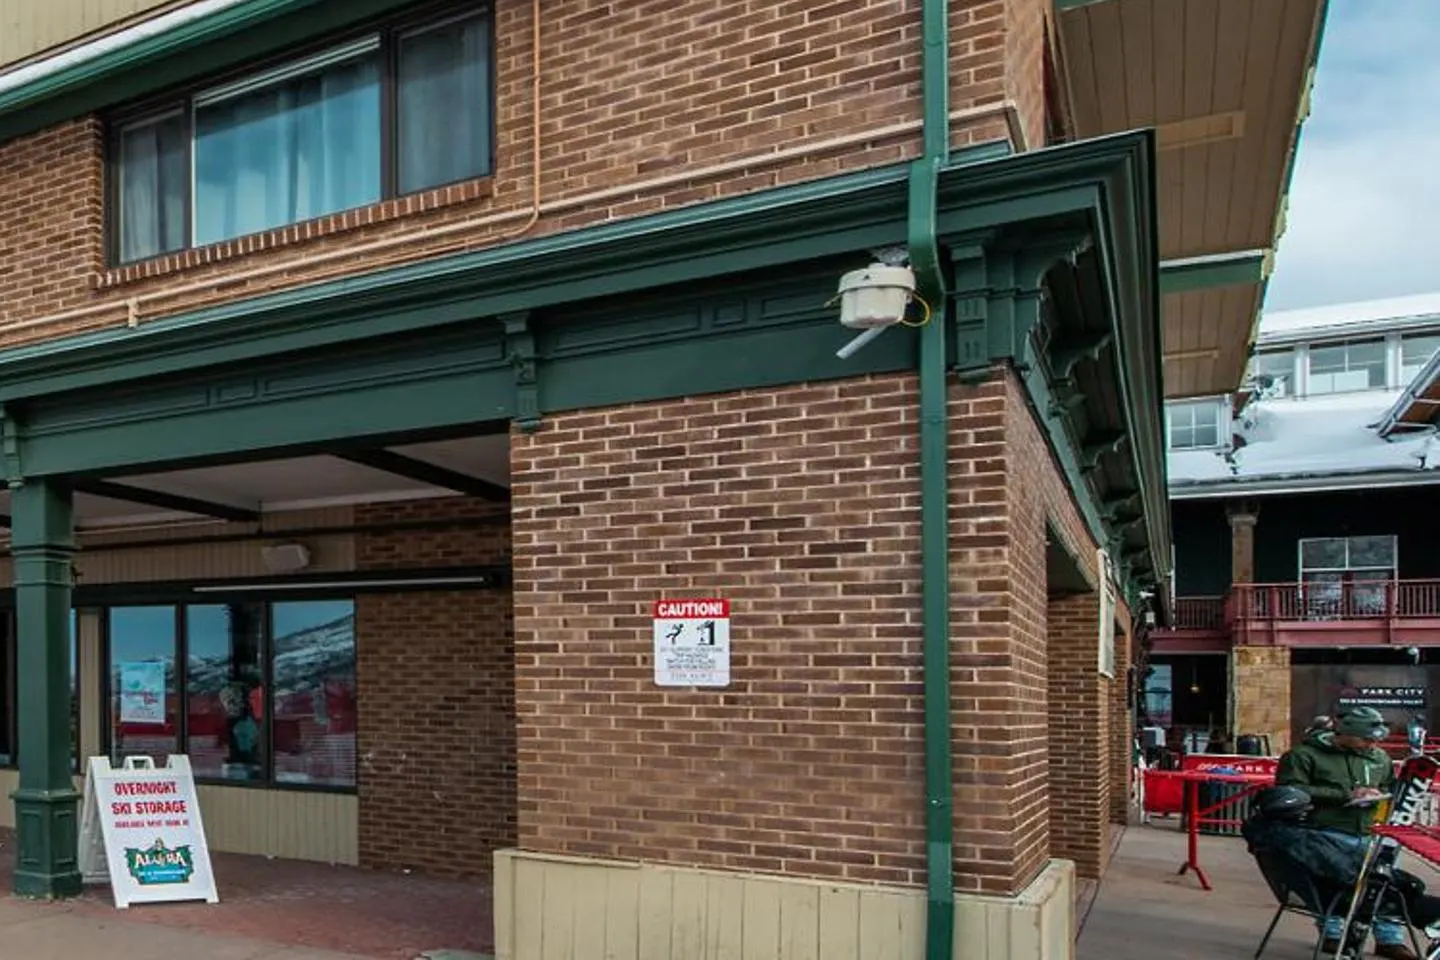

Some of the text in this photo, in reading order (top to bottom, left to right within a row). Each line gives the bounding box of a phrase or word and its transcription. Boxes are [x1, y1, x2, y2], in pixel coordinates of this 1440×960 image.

[658, 602, 723, 617] CAUTION!
[1362, 688, 1424, 696] PARK CITY
[114, 781, 176, 795] OVERNIGHT
[112, 800, 187, 815] SKI STORAGE
